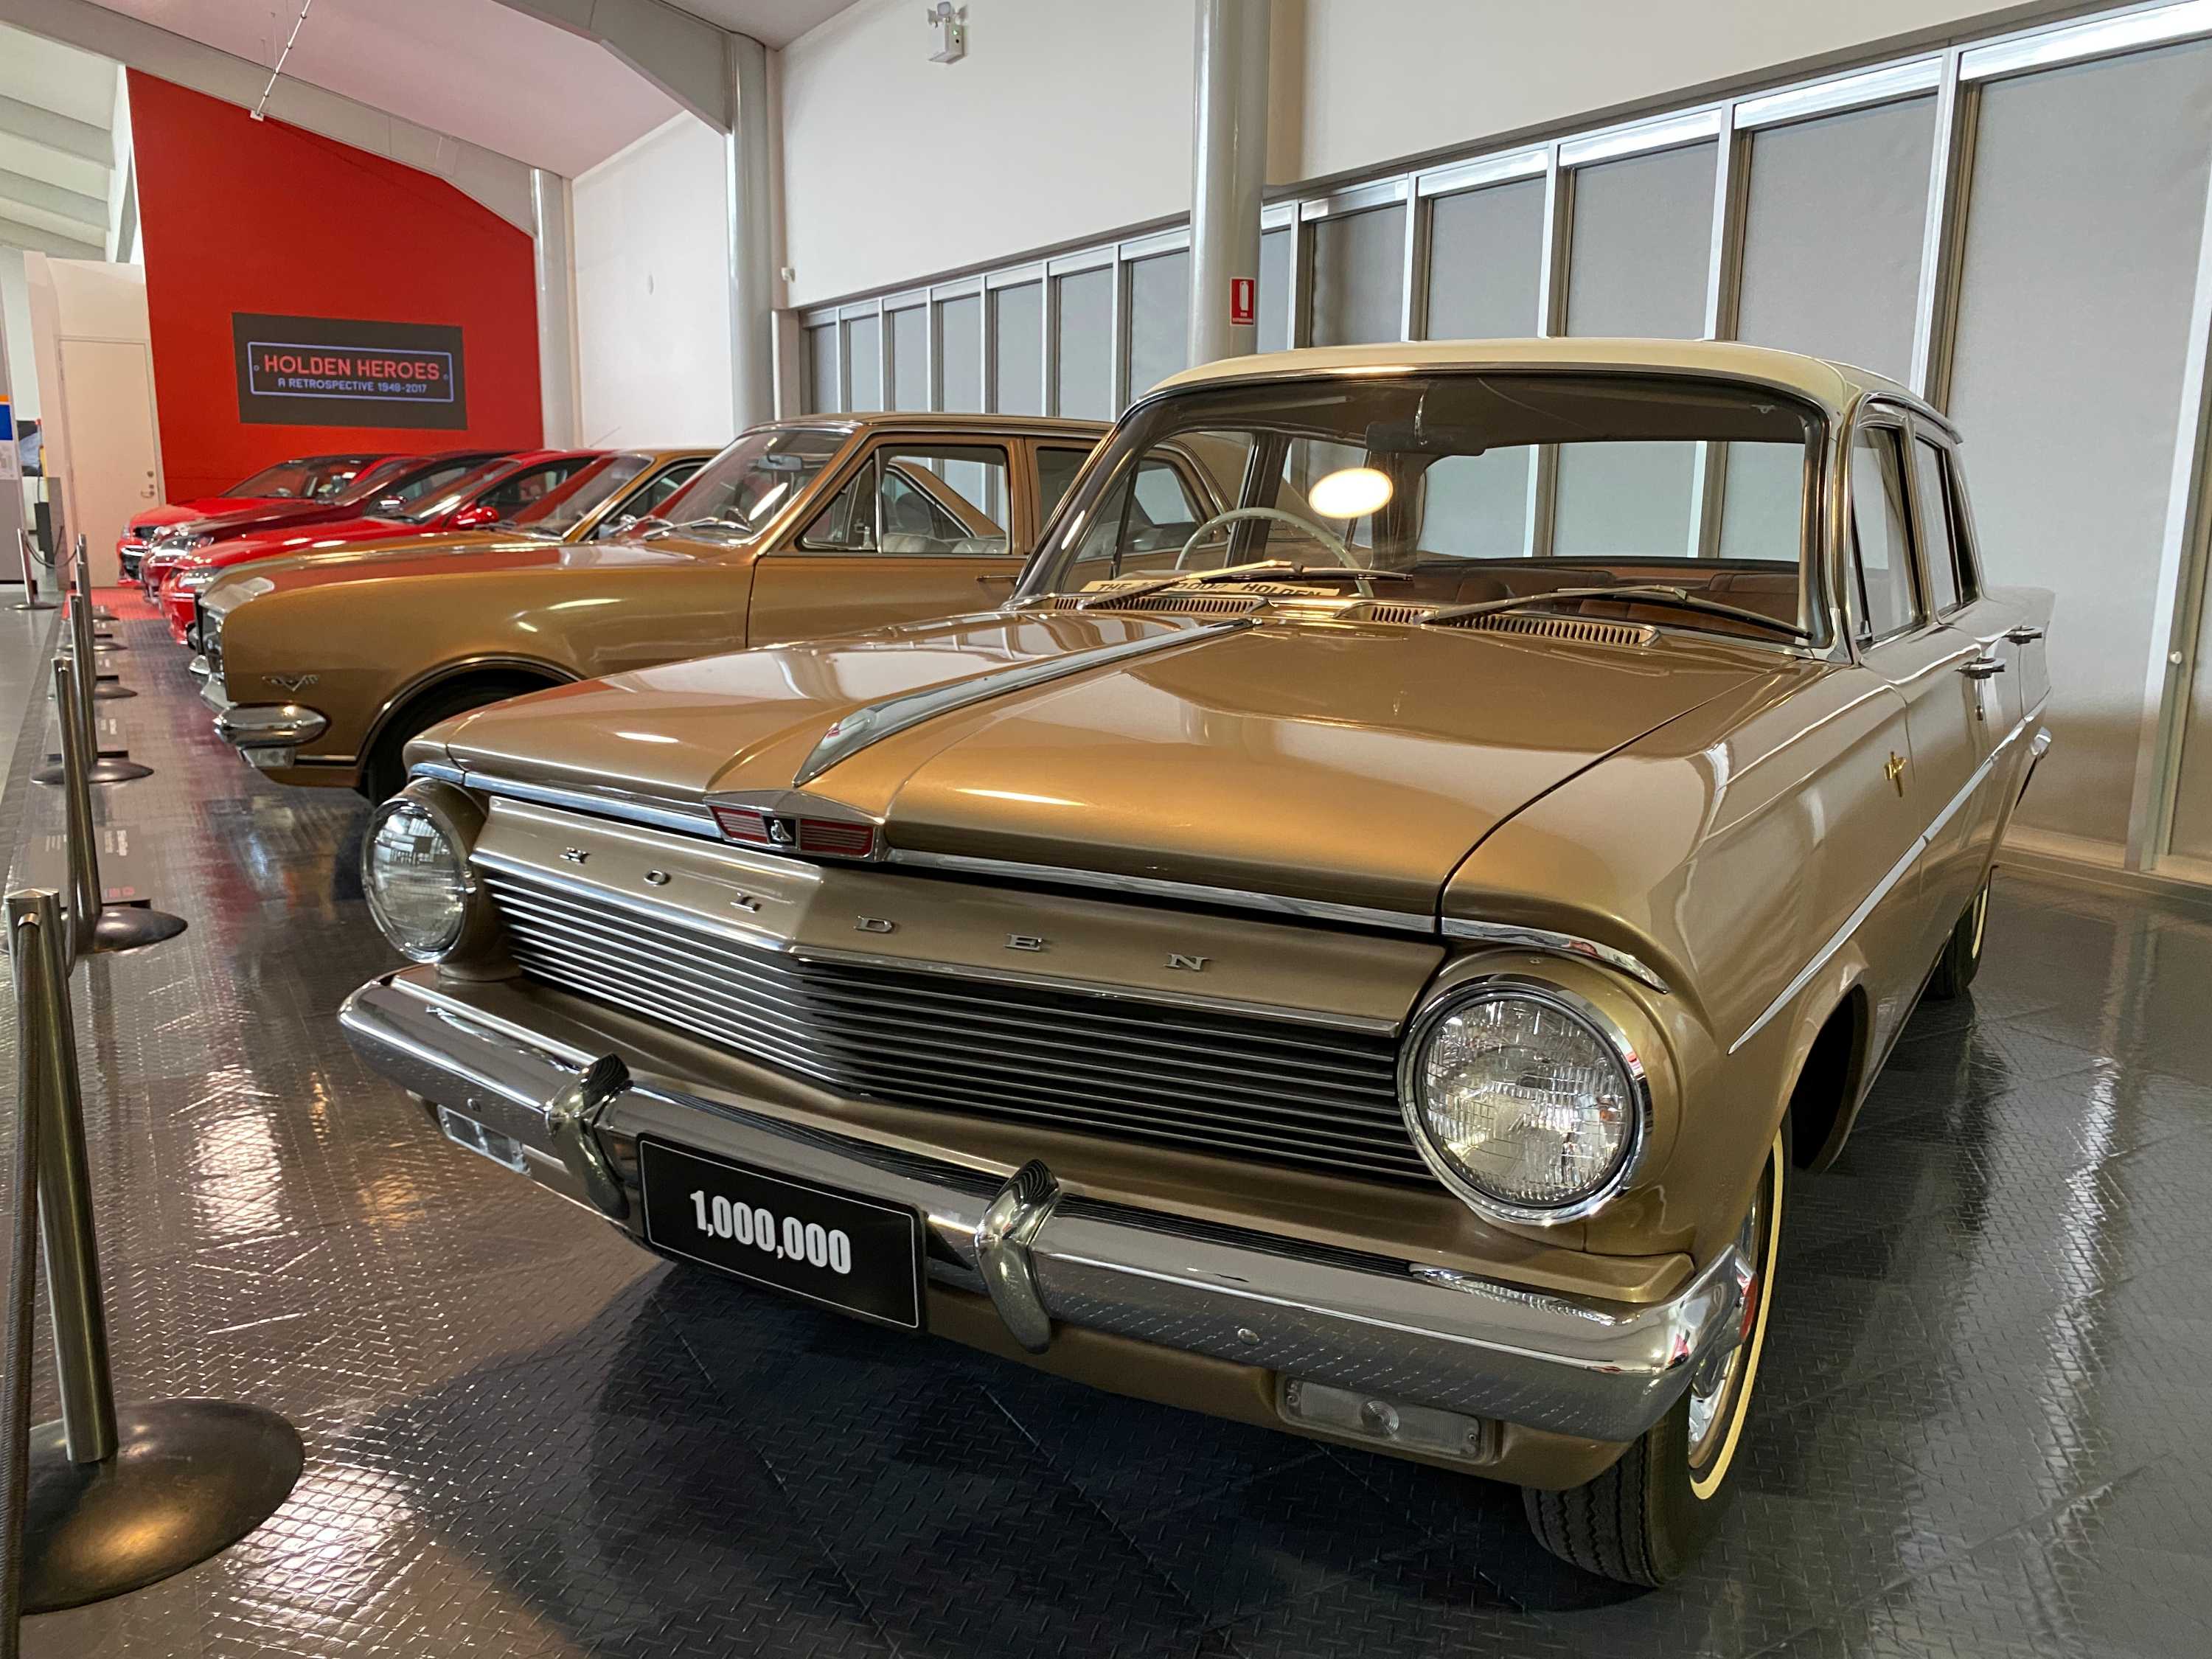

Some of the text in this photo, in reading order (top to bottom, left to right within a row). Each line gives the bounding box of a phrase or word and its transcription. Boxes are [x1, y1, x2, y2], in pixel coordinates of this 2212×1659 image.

[264, 354, 439, 380] HOLDEN HEROES
[277, 378, 285, 387] A
[288, 378, 375, 392] RETROSPECTIVE
[1097, 582, 1131, 591] THE
[560, 847, 1211, 970] HOLDEN
[689, 1189, 852, 1274] 1,000,000
